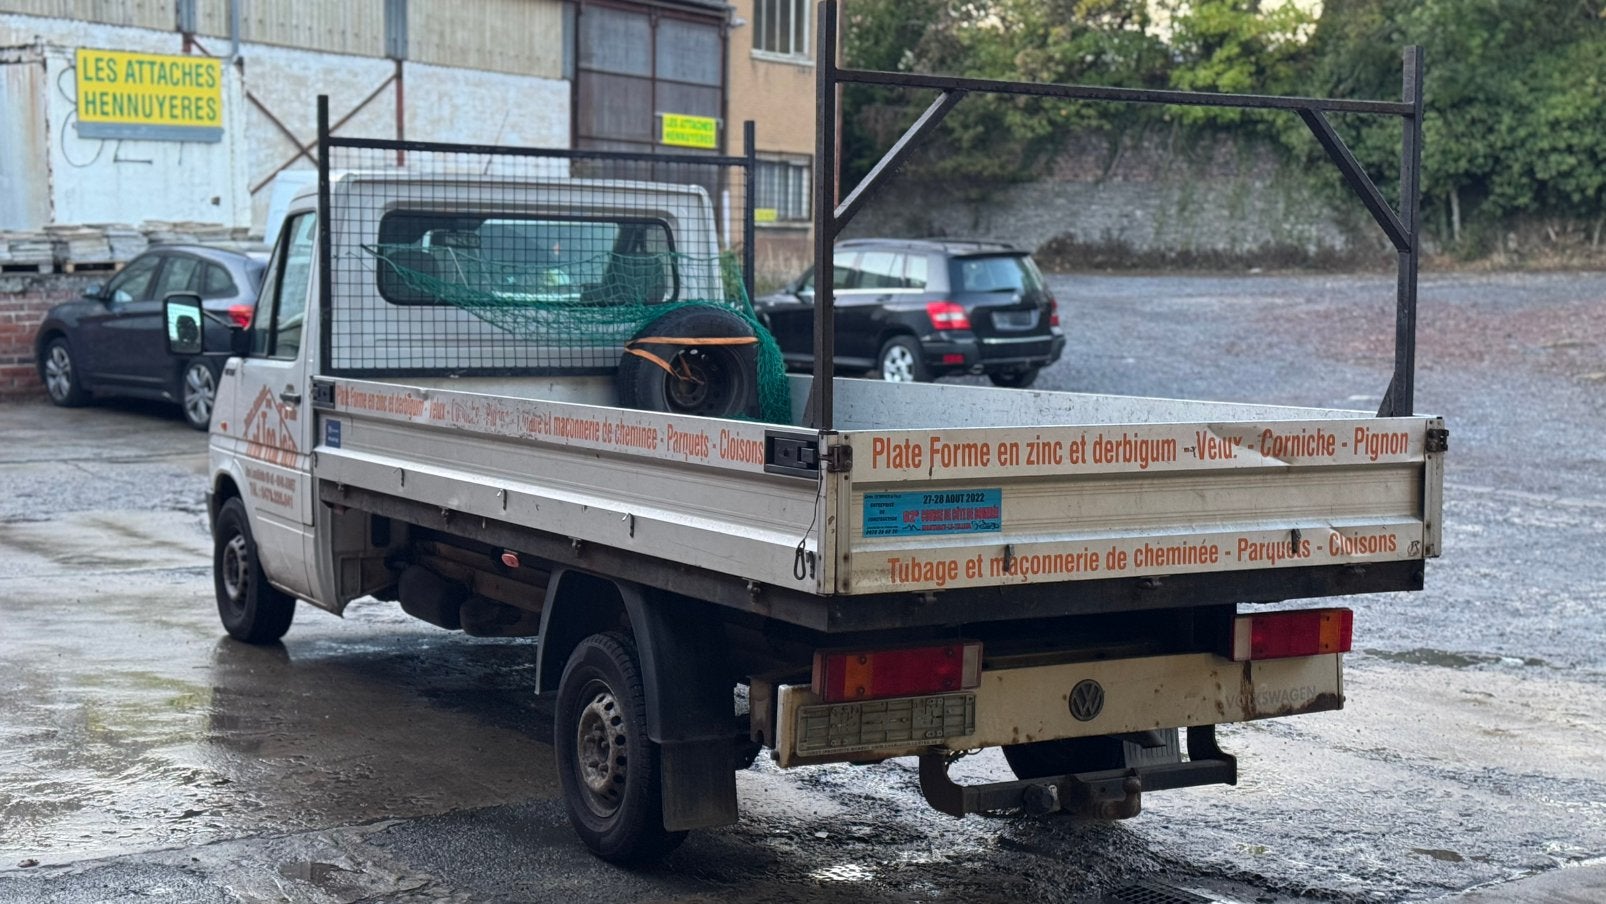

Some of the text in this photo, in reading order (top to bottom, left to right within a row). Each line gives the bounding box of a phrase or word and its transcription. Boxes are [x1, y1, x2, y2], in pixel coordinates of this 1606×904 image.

[83, 56, 216, 88] LES ATTACHES
[84, 91, 217, 121] HENNUYERES
[667, 423, 709, 461] Parquets
[720, 428, 764, 465] Cloisons
[872, 437, 922, 469] Plate
[929, 436, 991, 468] Forme
[998, 442, 1019, 466] en
[1026, 434, 1063, 465] zinc
[1069, 438, 1086, 465] et
[1092, 433, 1177, 470] derbigum
[1259, 427, 1336, 460] Corniche
[1353, 427, 1409, 462] Pignon
[923, 494, 944, 505] 27-28
[966, 492, 985, 503] 2022
[888, 557, 958, 587] Tubage
[965, 553, 983, 579] et
[990, 547, 1099, 583] maçonnerie
[1105, 546, 1127, 572] de
[1134, 538, 1219, 568] cheminée
[1328, 531, 1397, 556] Cloisons
